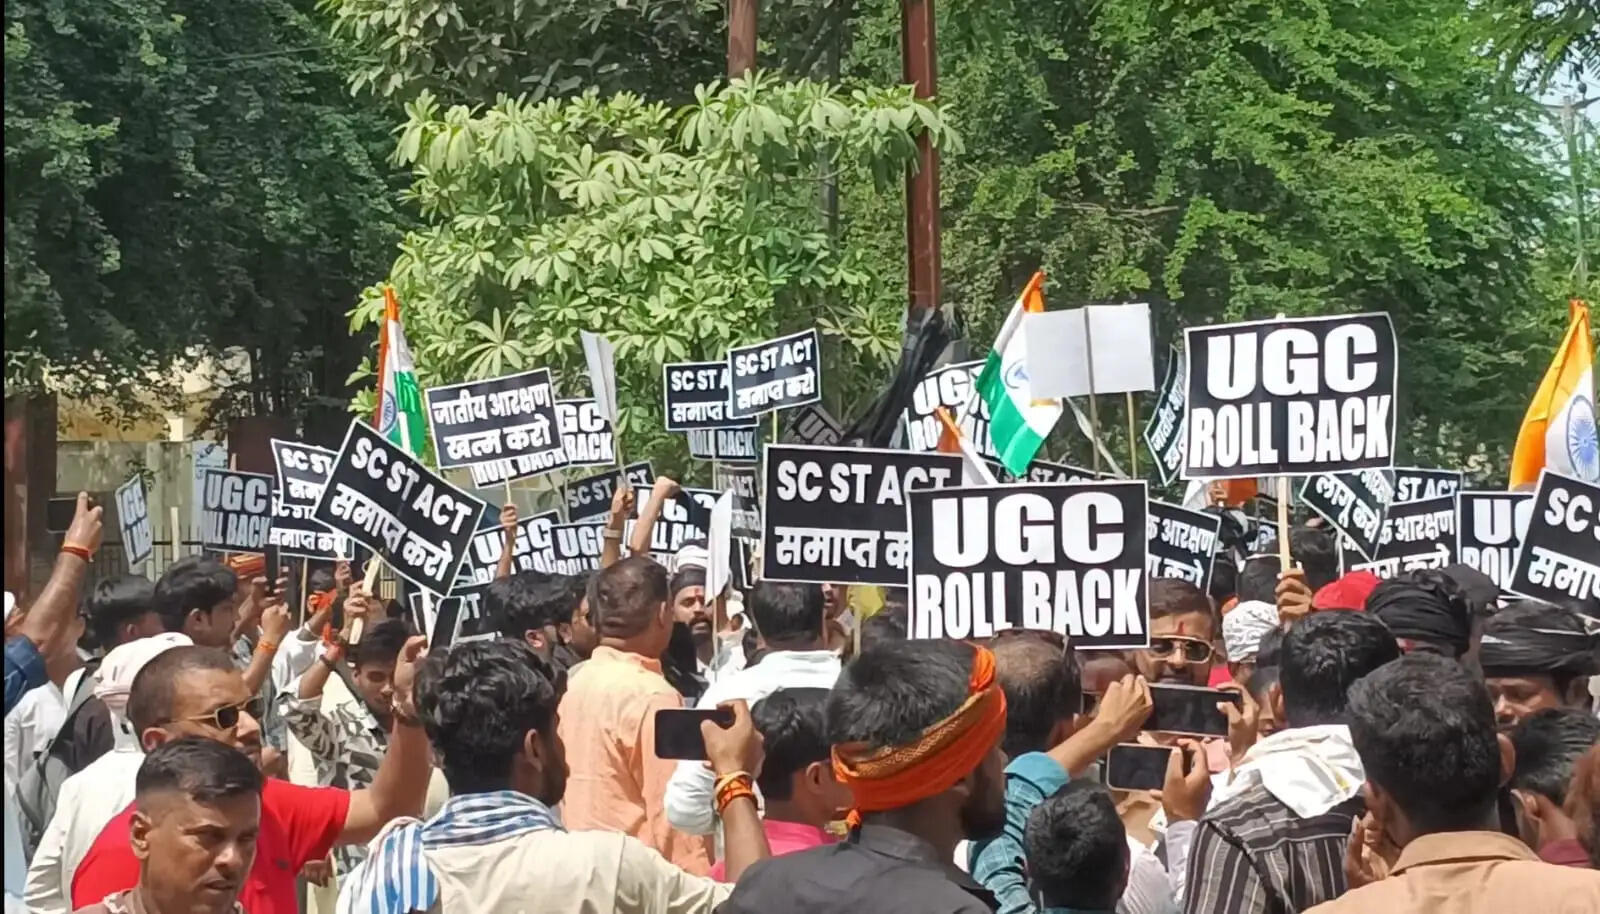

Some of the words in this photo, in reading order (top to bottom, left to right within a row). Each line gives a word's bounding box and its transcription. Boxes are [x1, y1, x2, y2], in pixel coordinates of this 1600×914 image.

[735, 353, 760, 377] SC
[760, 347, 779, 372] ST
[781, 338, 812, 367] ACT
[1207, 324, 1378, 400] UGC
[671, 370, 695, 391] SC
[697, 369, 718, 390] ST
[736, 379, 785, 409] समाप्त
[432, 389, 488, 425] जातीय
[489, 382, 551, 418] आरक्षण
[556, 403, 605, 433] GC
[671, 401, 723, 422] समाप्त
[443, 428, 503, 460] खत्म
[503, 413, 552, 450] करो
[1188, 401, 1278, 468] ROLL
[1287, 394, 1391, 464] BACK
[280, 448, 310, 471] SC
[205, 474, 268, 514] UGC
[351, 437, 388, 480] SC
[386, 460, 420, 502] ST
[412, 483, 473, 535] ACT
[567, 488, 591, 509] SC
[593, 479, 614, 502] ST
[777, 460, 823, 502] SC
[830, 463, 872, 504] ST
[1397, 477, 1423, 501] ST
[932, 491, 1124, 567] UGC
[1395, 509, 1455, 542] आरक्षण
[1544, 488, 1593, 533] SC
[226, 514, 271, 548] BACK
[330, 483, 407, 554] समाप्त
[402, 530, 454, 582] करो
[775, 526, 881, 569] समाप्त
[1161, 518, 1216, 558] आरक्षण
[915, 572, 1013, 640] ROLL
[1023, 568, 1144, 636] BACK
